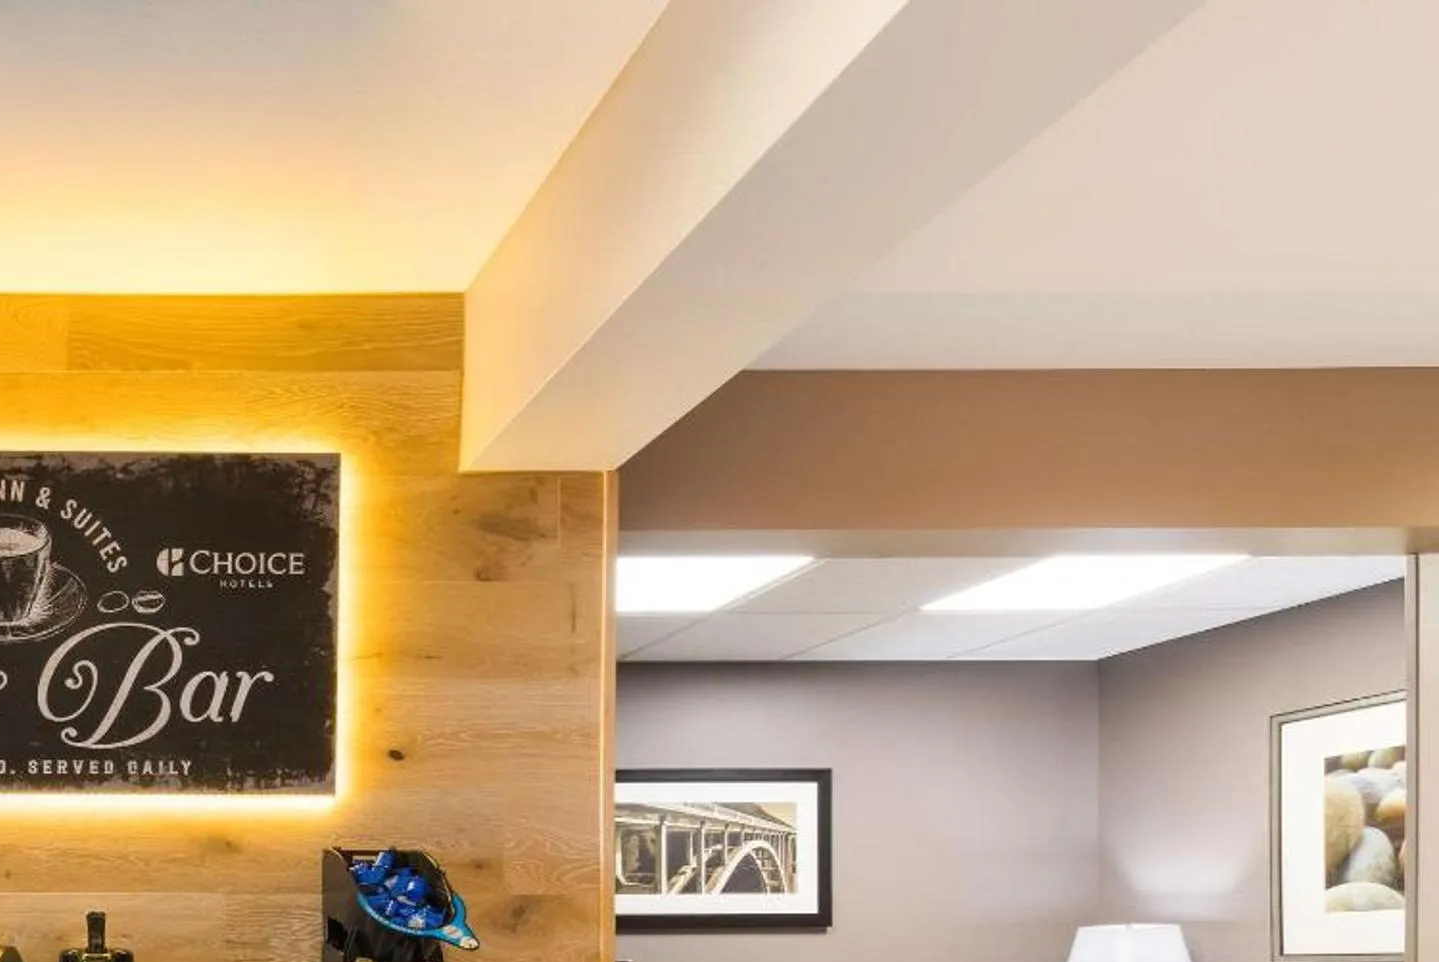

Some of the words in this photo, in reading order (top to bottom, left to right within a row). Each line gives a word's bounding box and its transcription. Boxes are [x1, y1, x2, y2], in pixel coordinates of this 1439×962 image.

[35, 486, 51, 510] &
[60, 499, 128, 573] SUITES
[189, 550, 306, 575] CHOICE
[219, 579, 274, 589] HOTELS
[37, 622, 275, 750] Bar
[27, 759, 115, 775] SERVED
[127, 760, 192, 777] DAILY
